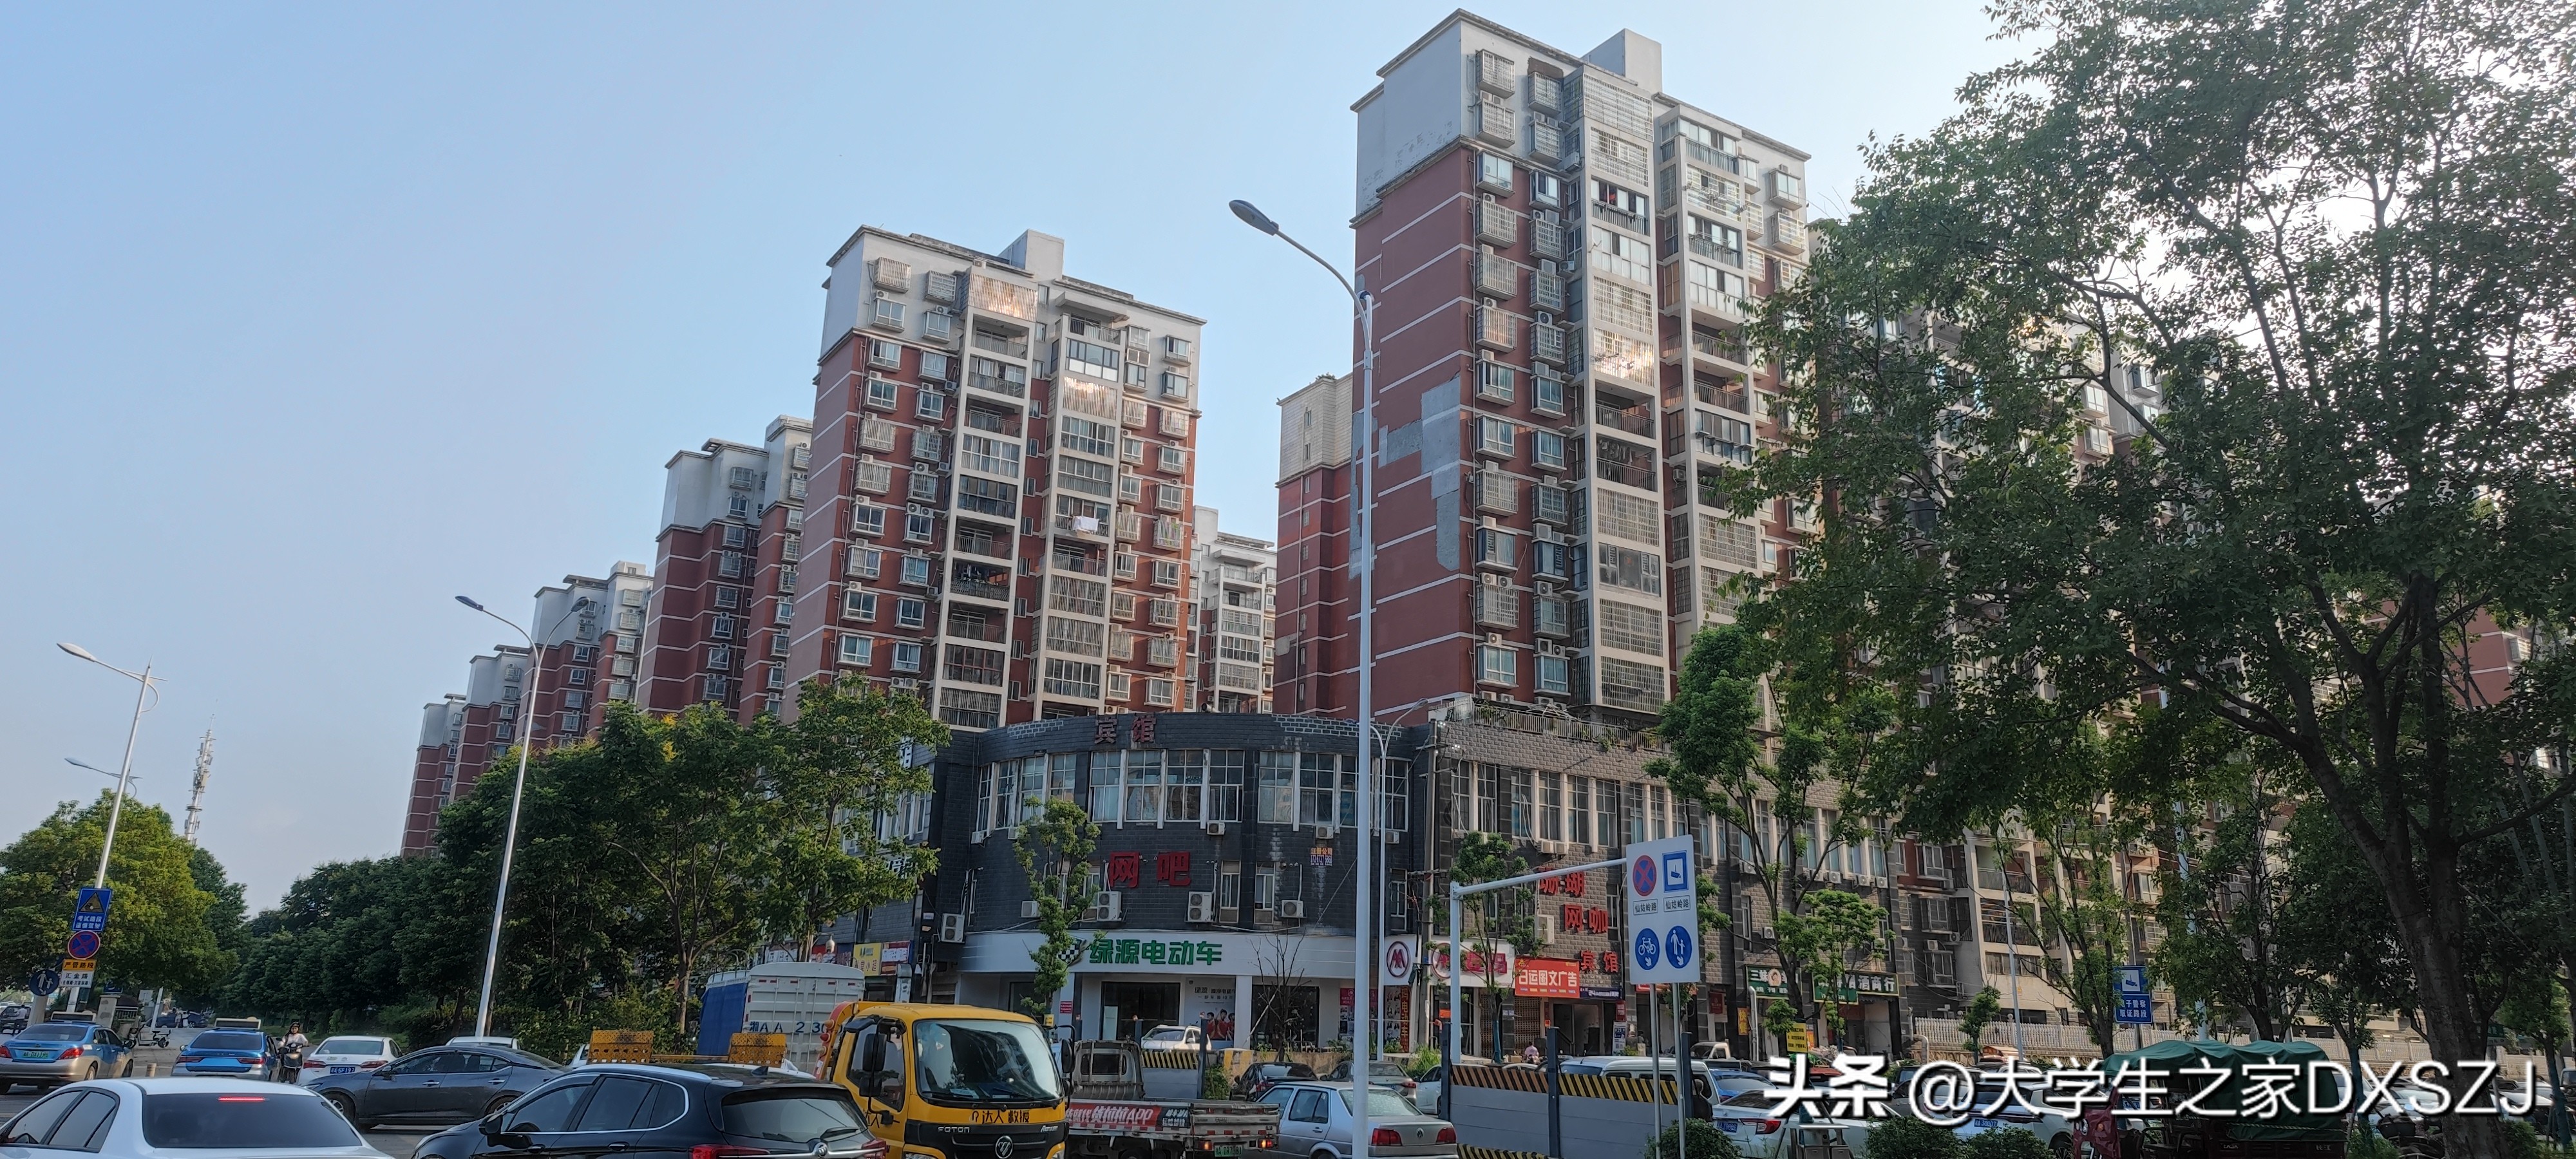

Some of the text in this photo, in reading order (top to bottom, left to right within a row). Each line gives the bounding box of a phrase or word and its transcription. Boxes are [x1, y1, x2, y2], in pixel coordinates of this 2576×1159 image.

[1094, 716, 1157, 744] 宾馆
[1108, 851, 1191, 888] 网吧
[1538, 867, 1585, 896] 珊瑚
[1634, 902, 1657, 913] 仙姑岭路
[1665, 899, 1689, 909] 仙姑岭路
[1564, 904, 1608, 933] 网咖
[1089, 939, 1222, 966] 绿源电动车
[1580, 950, 1618, 973] 宾馆
[2119, 1009, 2146, 1017] 取证路段
[2122, 999, 2146, 1008] 子警察
